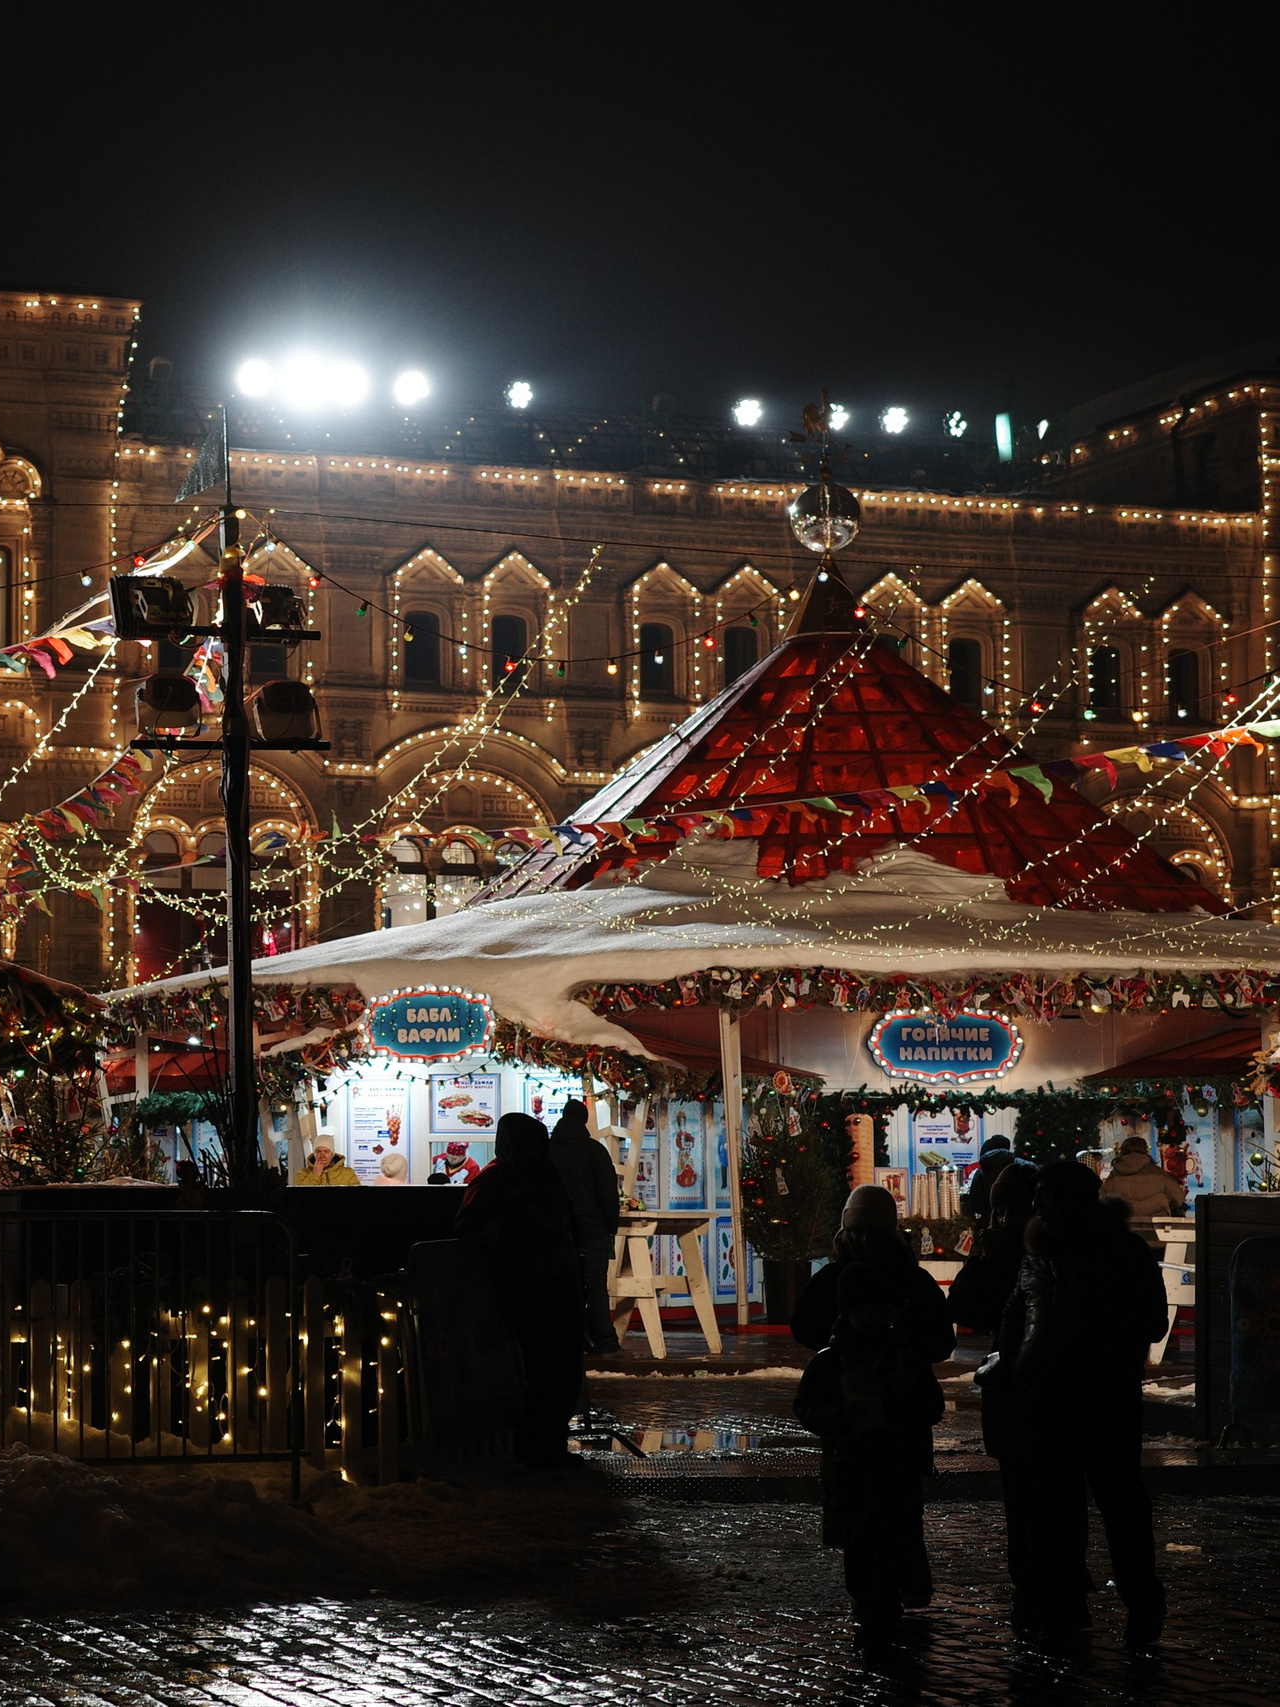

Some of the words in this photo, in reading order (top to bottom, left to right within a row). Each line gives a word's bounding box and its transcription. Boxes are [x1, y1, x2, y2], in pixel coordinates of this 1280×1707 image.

[406, 1007, 451, 1023] БАБЛ
[397, 1027, 460, 1043] ВАФЛИ
[901, 1027, 990, 1041] ГОРЯЧИЕ
[899, 1046, 992, 1061] НАПИТКИ
